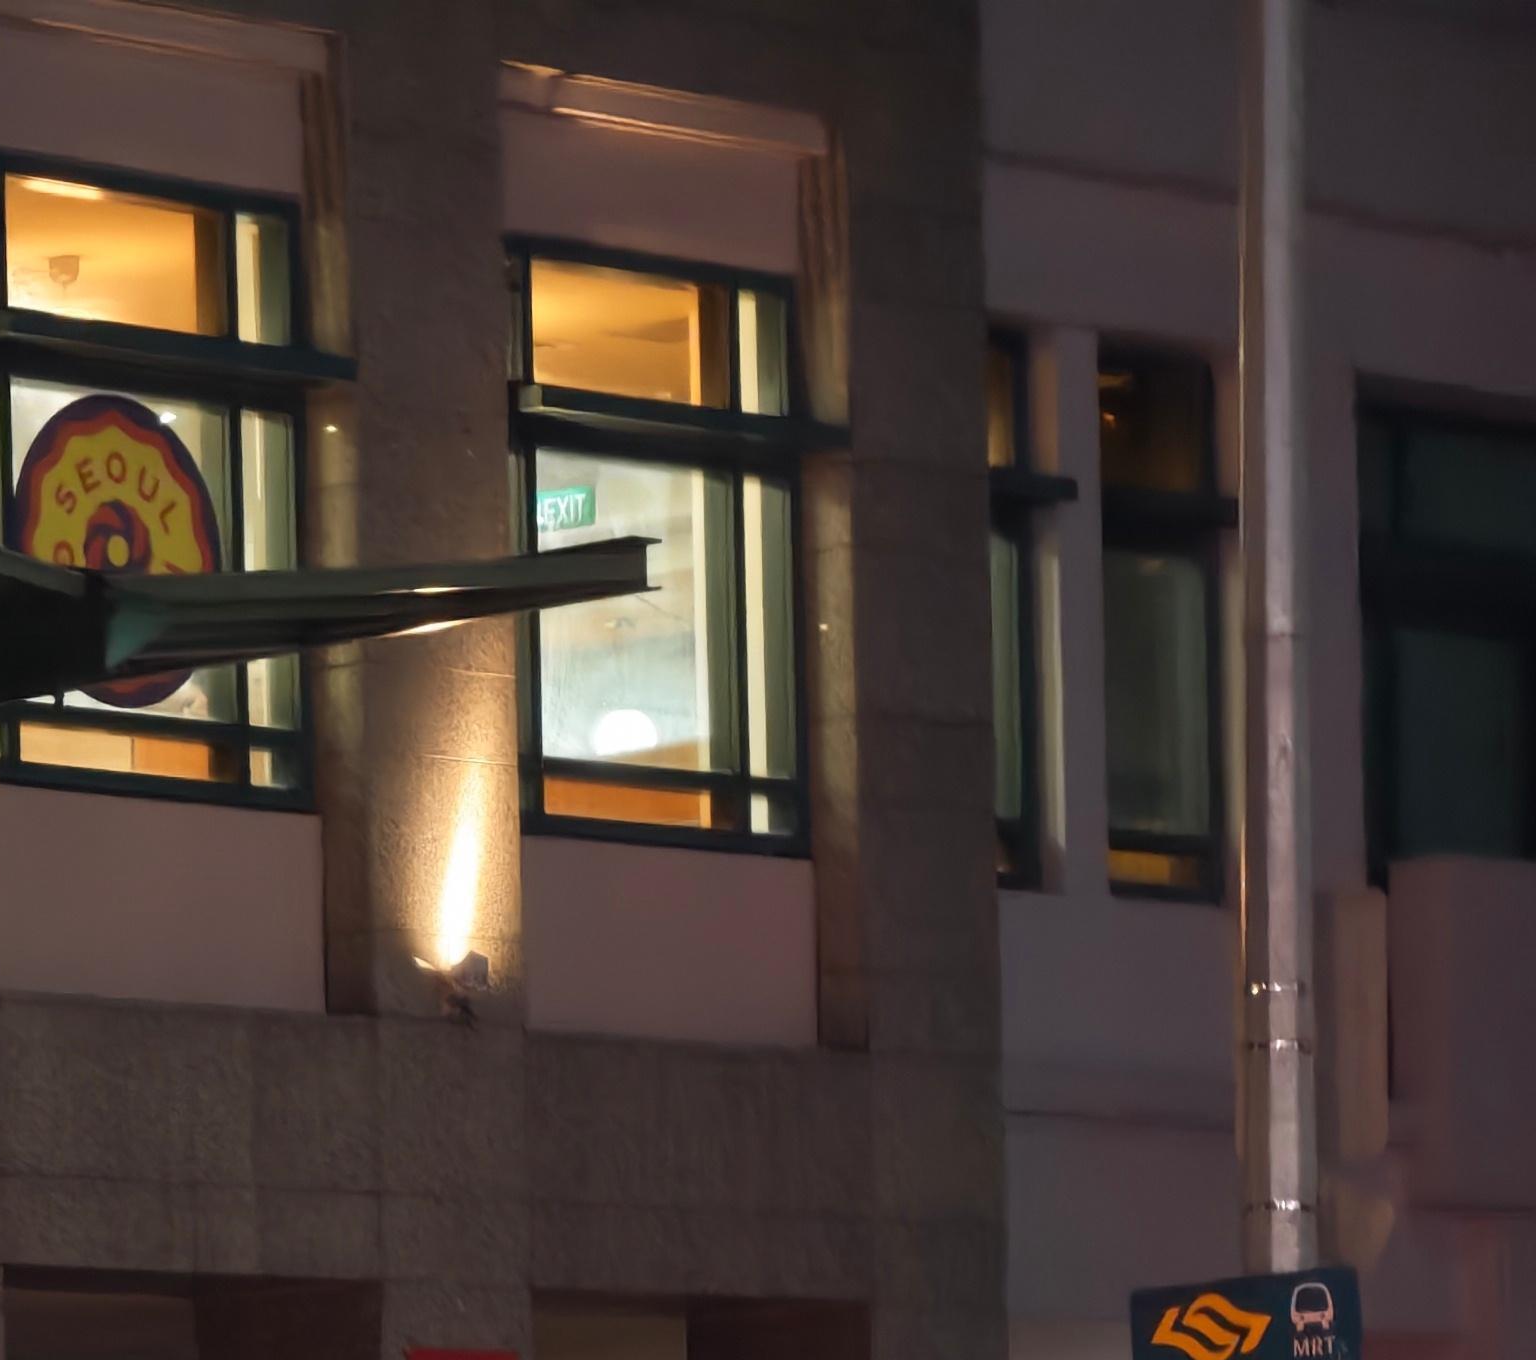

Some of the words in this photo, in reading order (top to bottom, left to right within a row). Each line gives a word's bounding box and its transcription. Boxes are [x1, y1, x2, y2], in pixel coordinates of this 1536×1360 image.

[54, 451, 179, 534] SEOUL
[544, 493, 587, 527] EXIT
[1293, 1334, 1336, 1358] MRT
